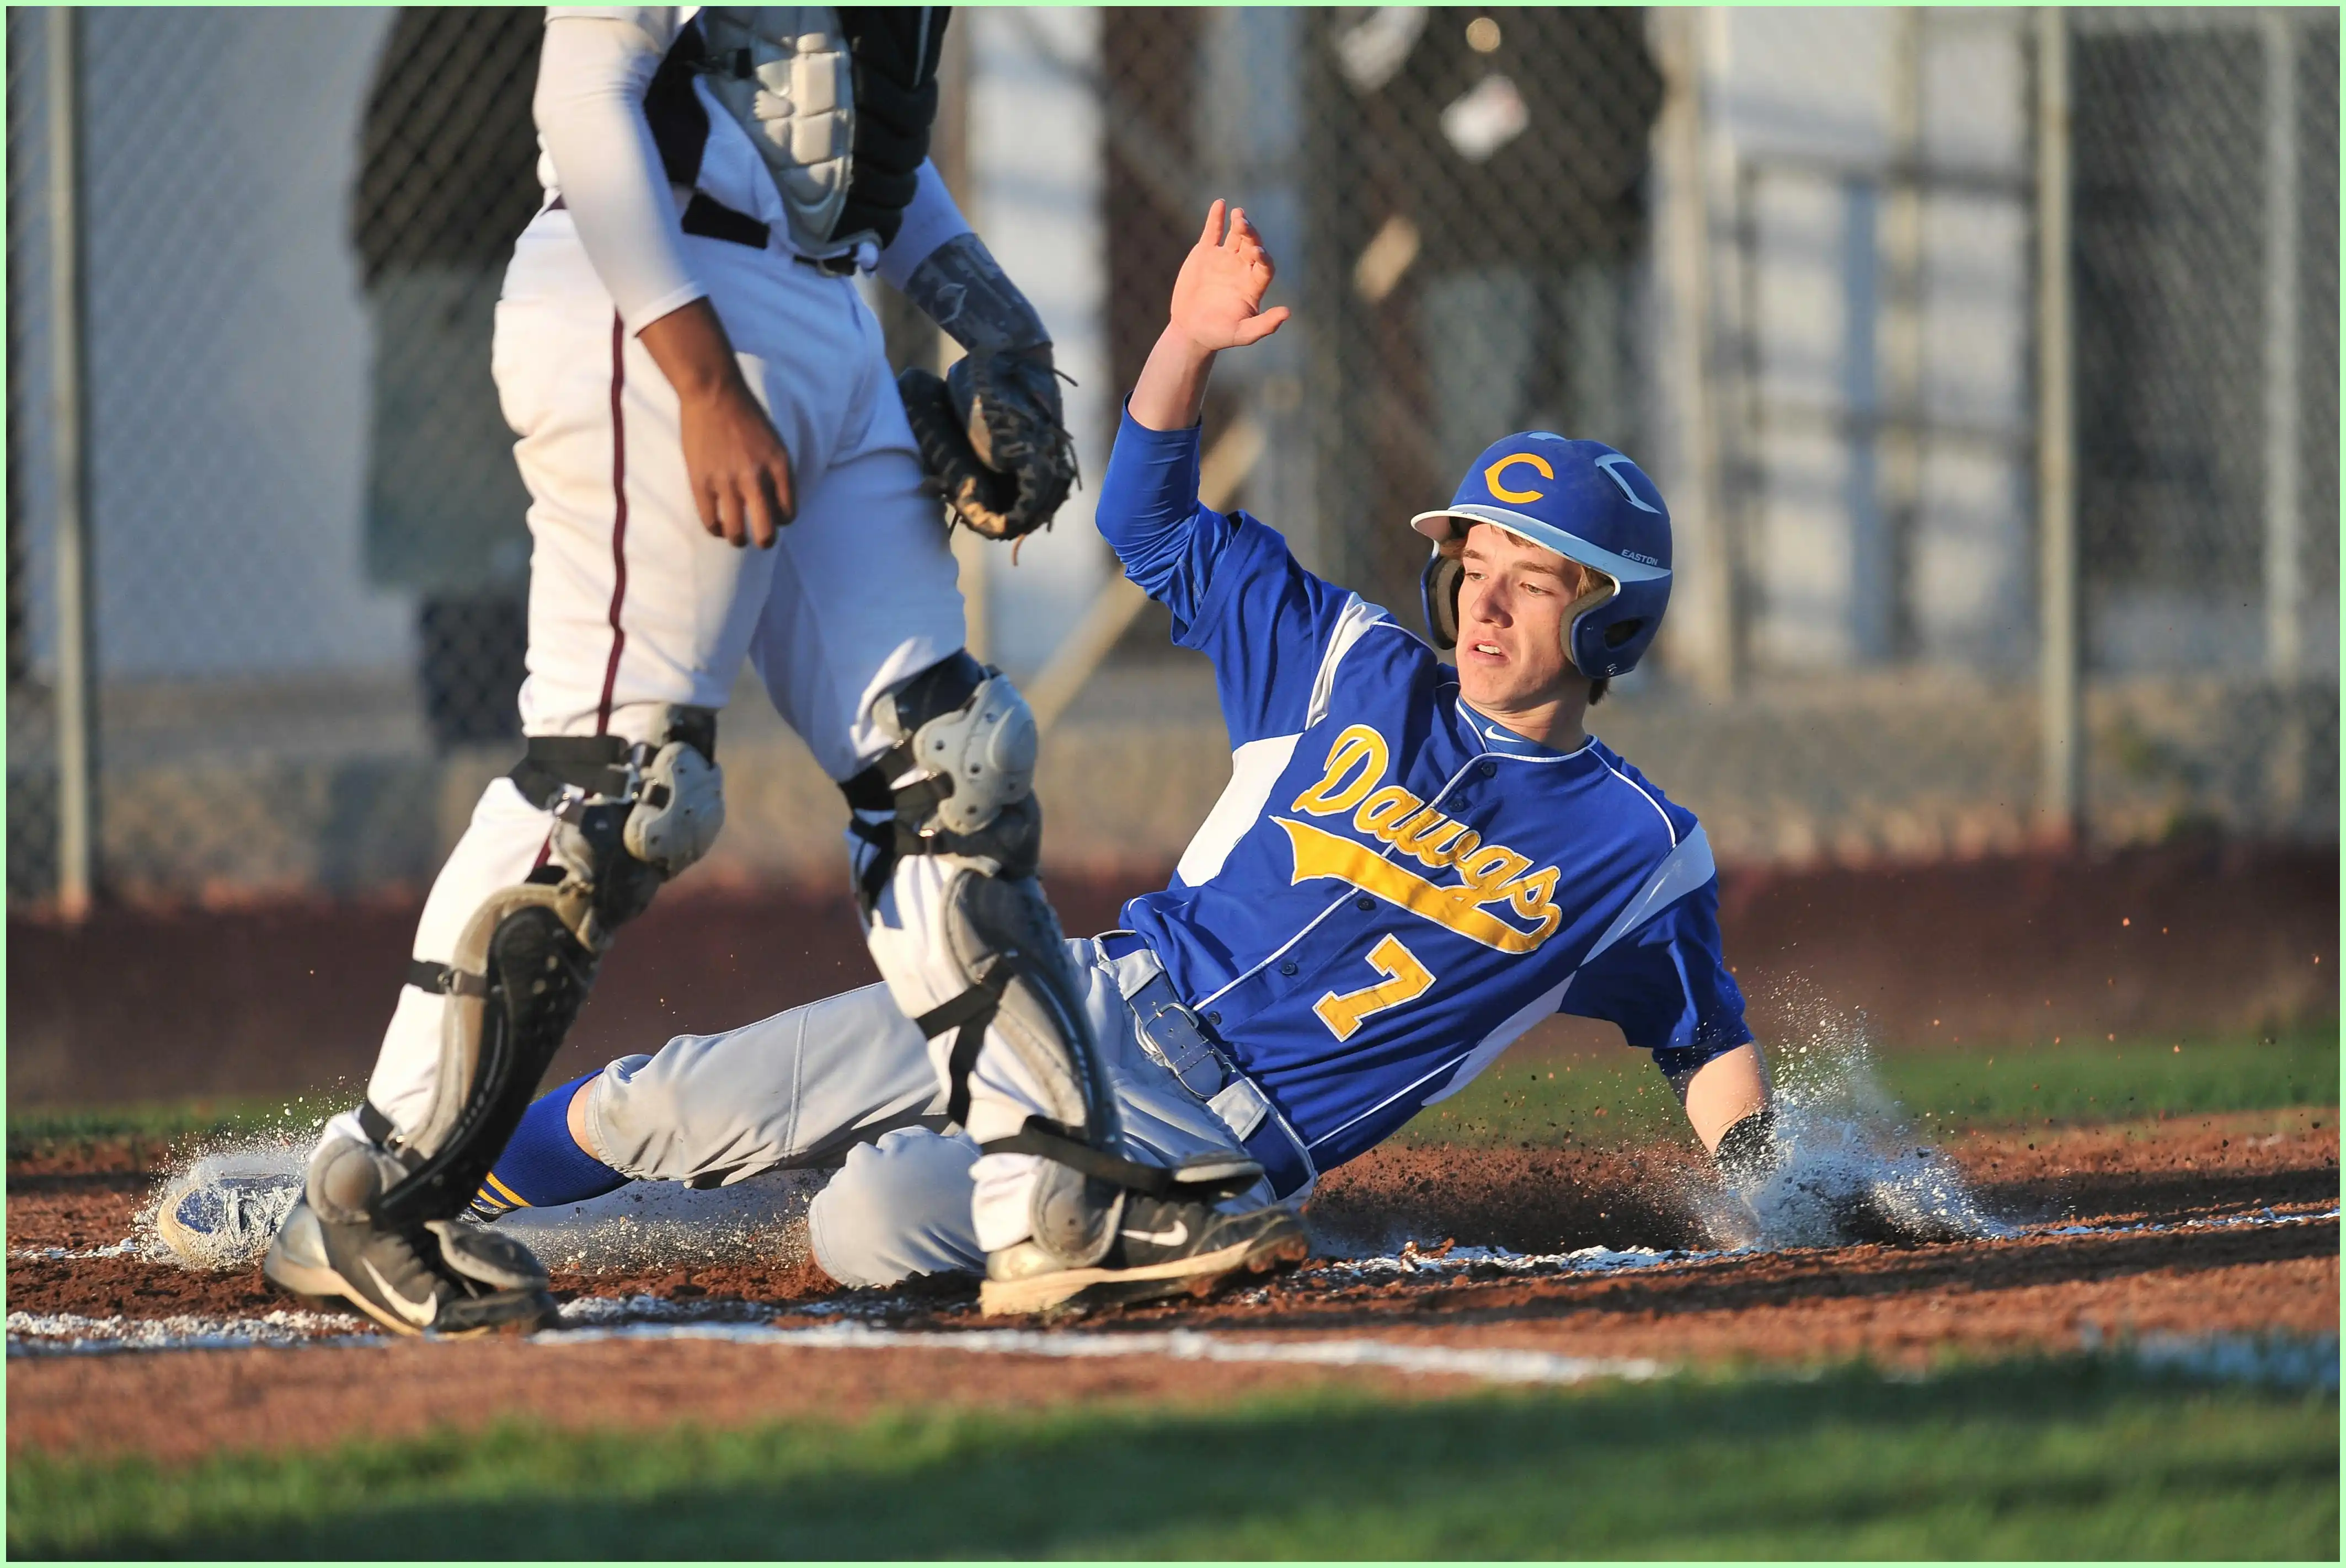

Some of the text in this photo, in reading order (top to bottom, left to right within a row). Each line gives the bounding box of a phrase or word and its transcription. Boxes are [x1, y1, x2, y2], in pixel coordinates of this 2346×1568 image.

[1484, 452, 1554, 504] C
[1621, 549, 1658, 566] EASTON
[1291, 724, 1562, 955] Dawgs
[1312, 933, 1436, 1042] 7
